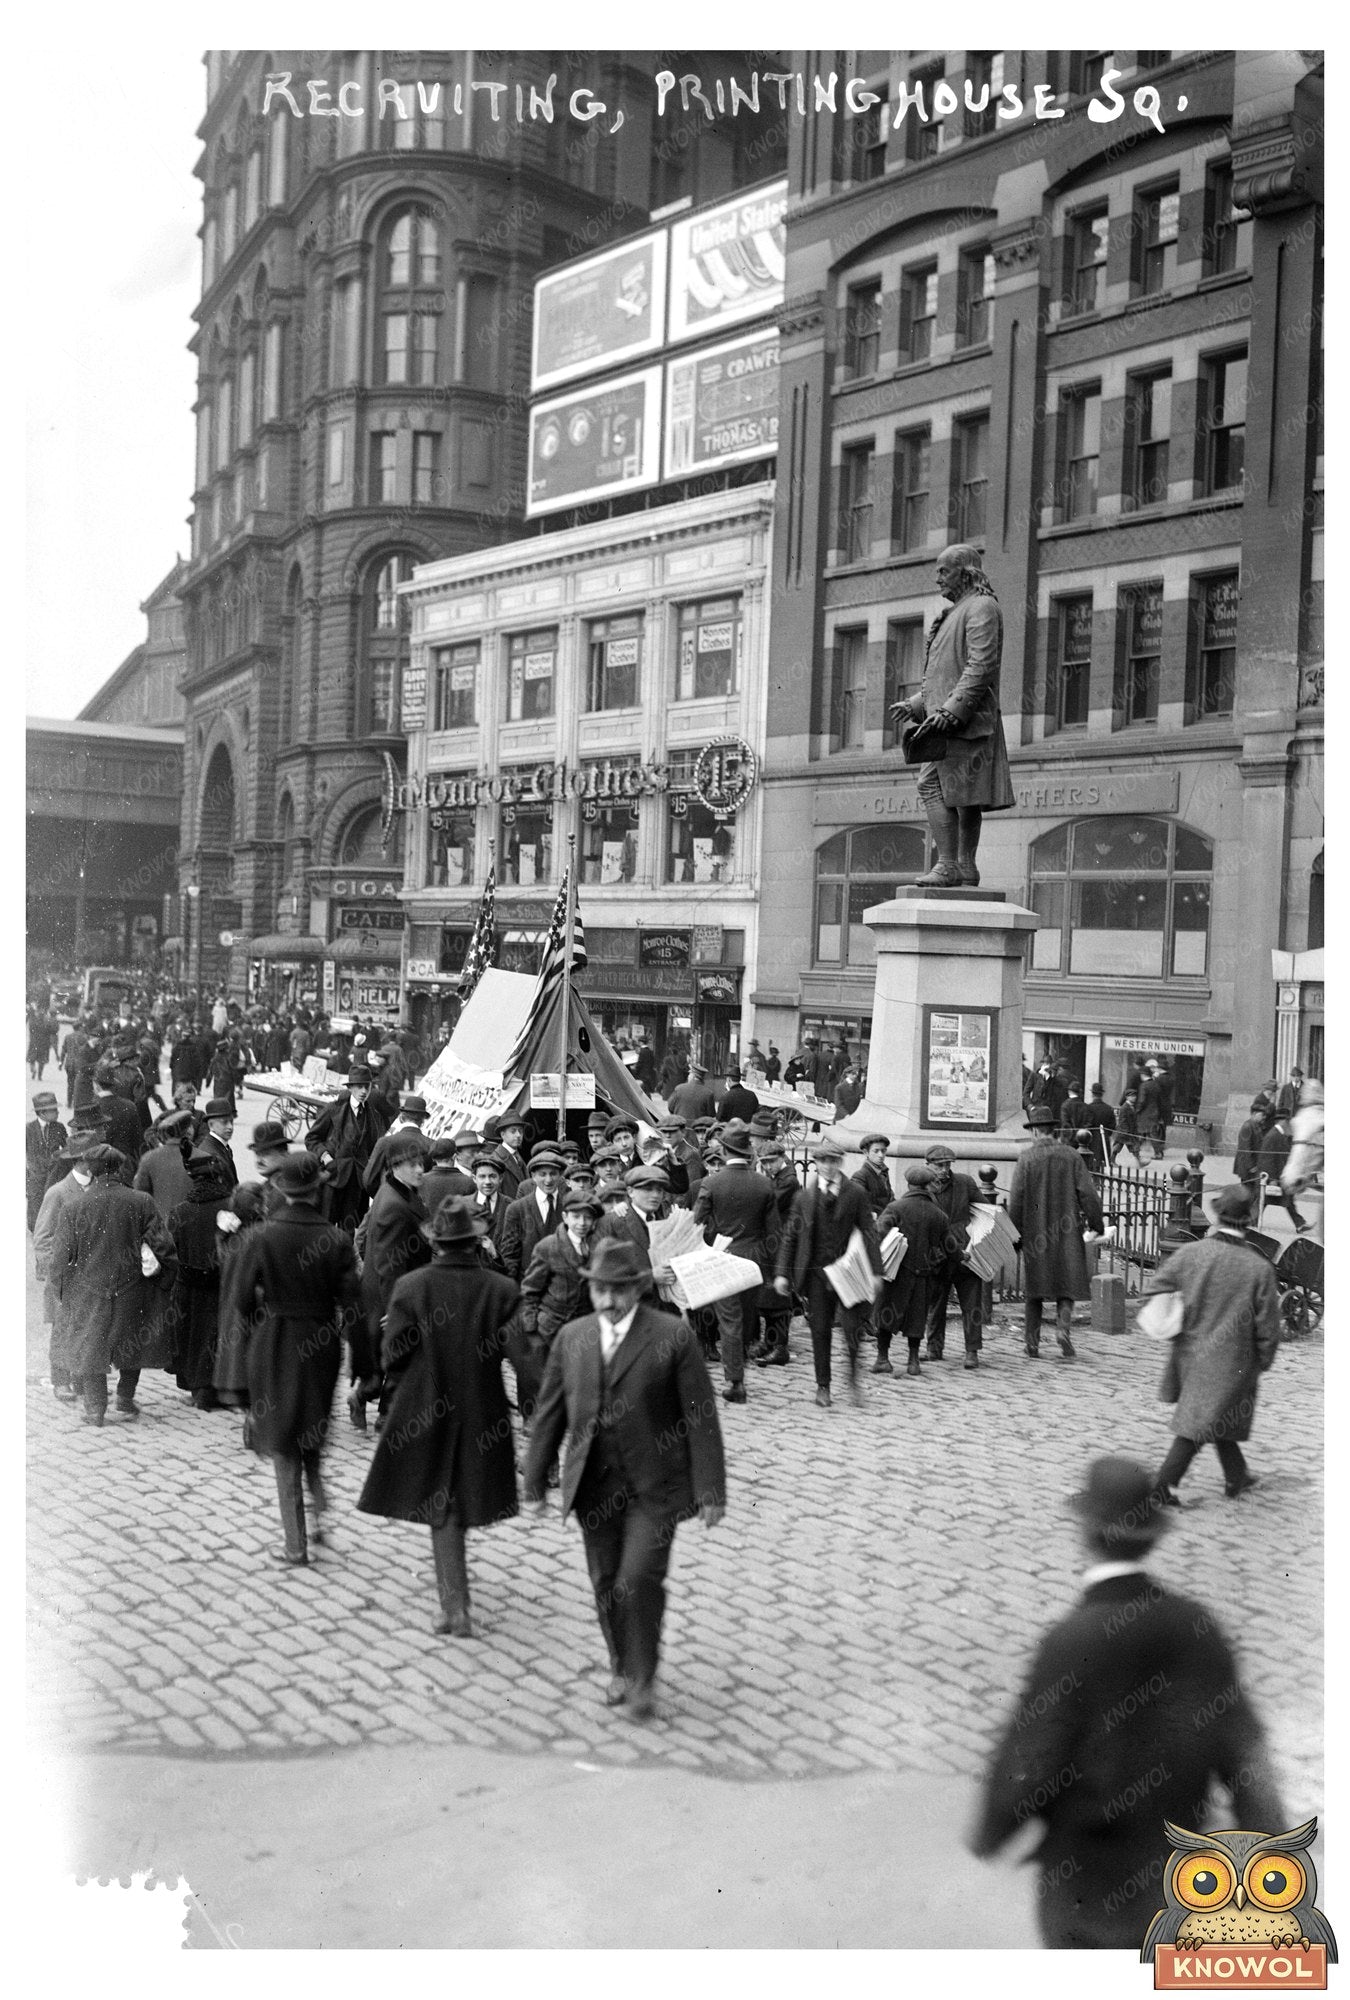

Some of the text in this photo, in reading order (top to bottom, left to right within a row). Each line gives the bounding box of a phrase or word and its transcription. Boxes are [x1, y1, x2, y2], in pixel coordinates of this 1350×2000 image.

[691, 199, 787, 255] United States
[702, 422, 757, 453] THOMAS
[398, 757, 669, 810] Monroe Clothes
[582, 801, 596, 818] $15
[670, 795, 687, 813] $15
[874, 796, 928, 814] CLAR
[502, 806, 516, 823] $15
[334, 880, 397, 897] CIGA
[358, 988, 400, 1004] HELM
[1114, 1039, 1194, 1053] WESTERN UNION
